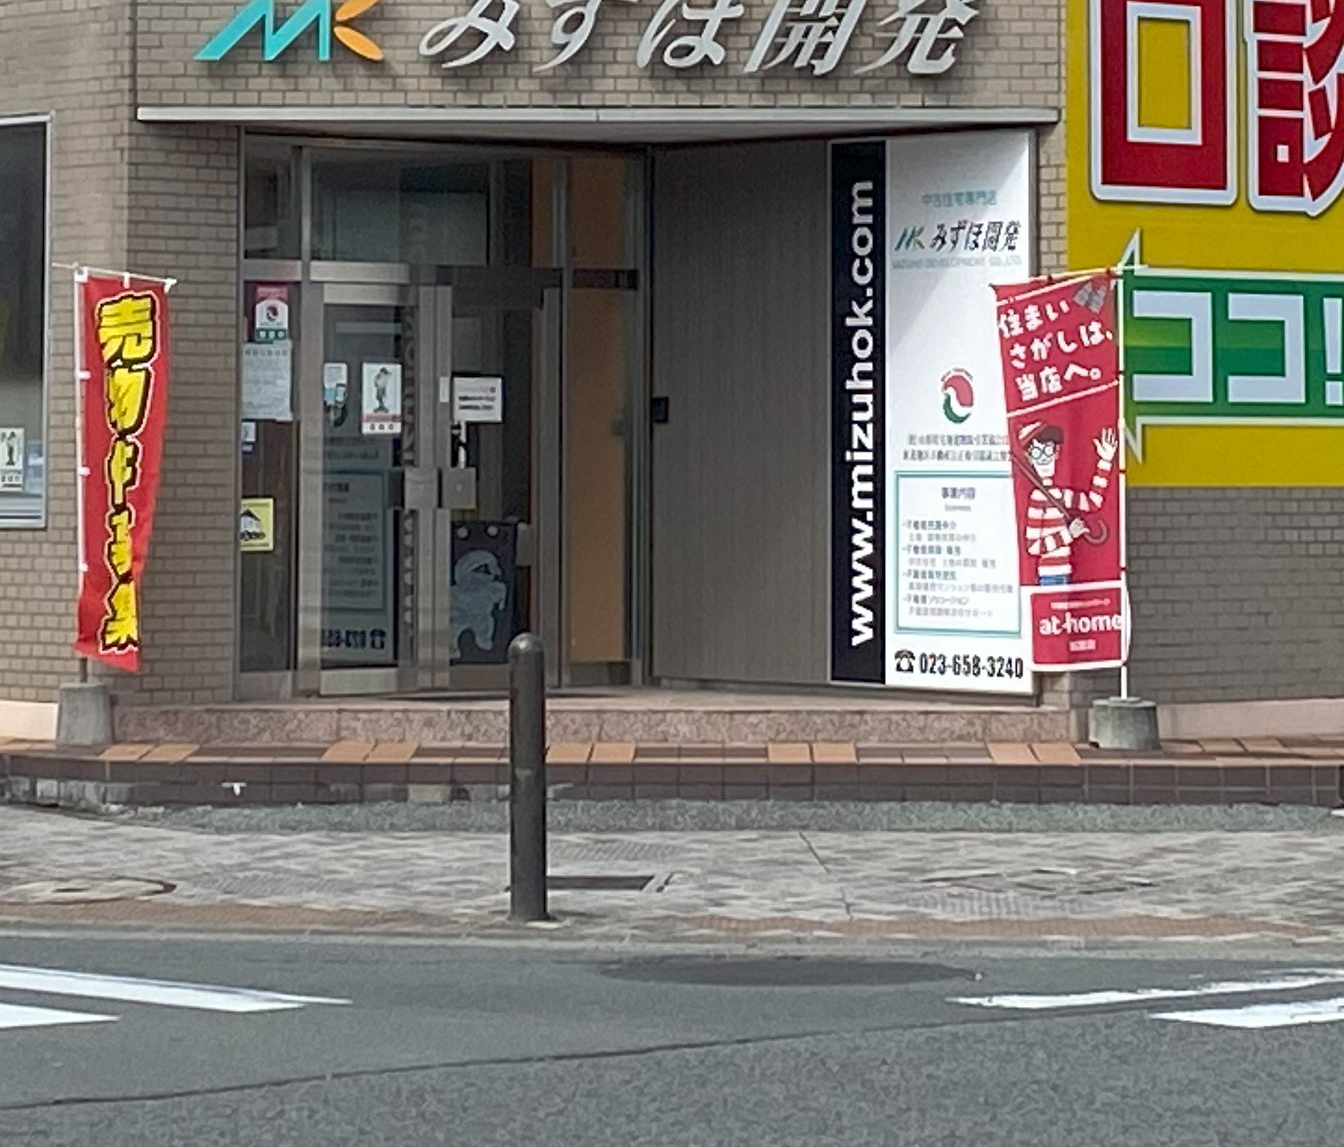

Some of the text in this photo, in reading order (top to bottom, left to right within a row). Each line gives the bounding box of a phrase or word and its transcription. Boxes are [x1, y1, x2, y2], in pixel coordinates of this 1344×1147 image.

[930, 219, 1021, 252] みずほ開発
[998, 300, 1070, 338] 住まい
[845, 180, 874, 646] www.mizuhok.com
[919, 652, 1024, 679] 023-658-3240
